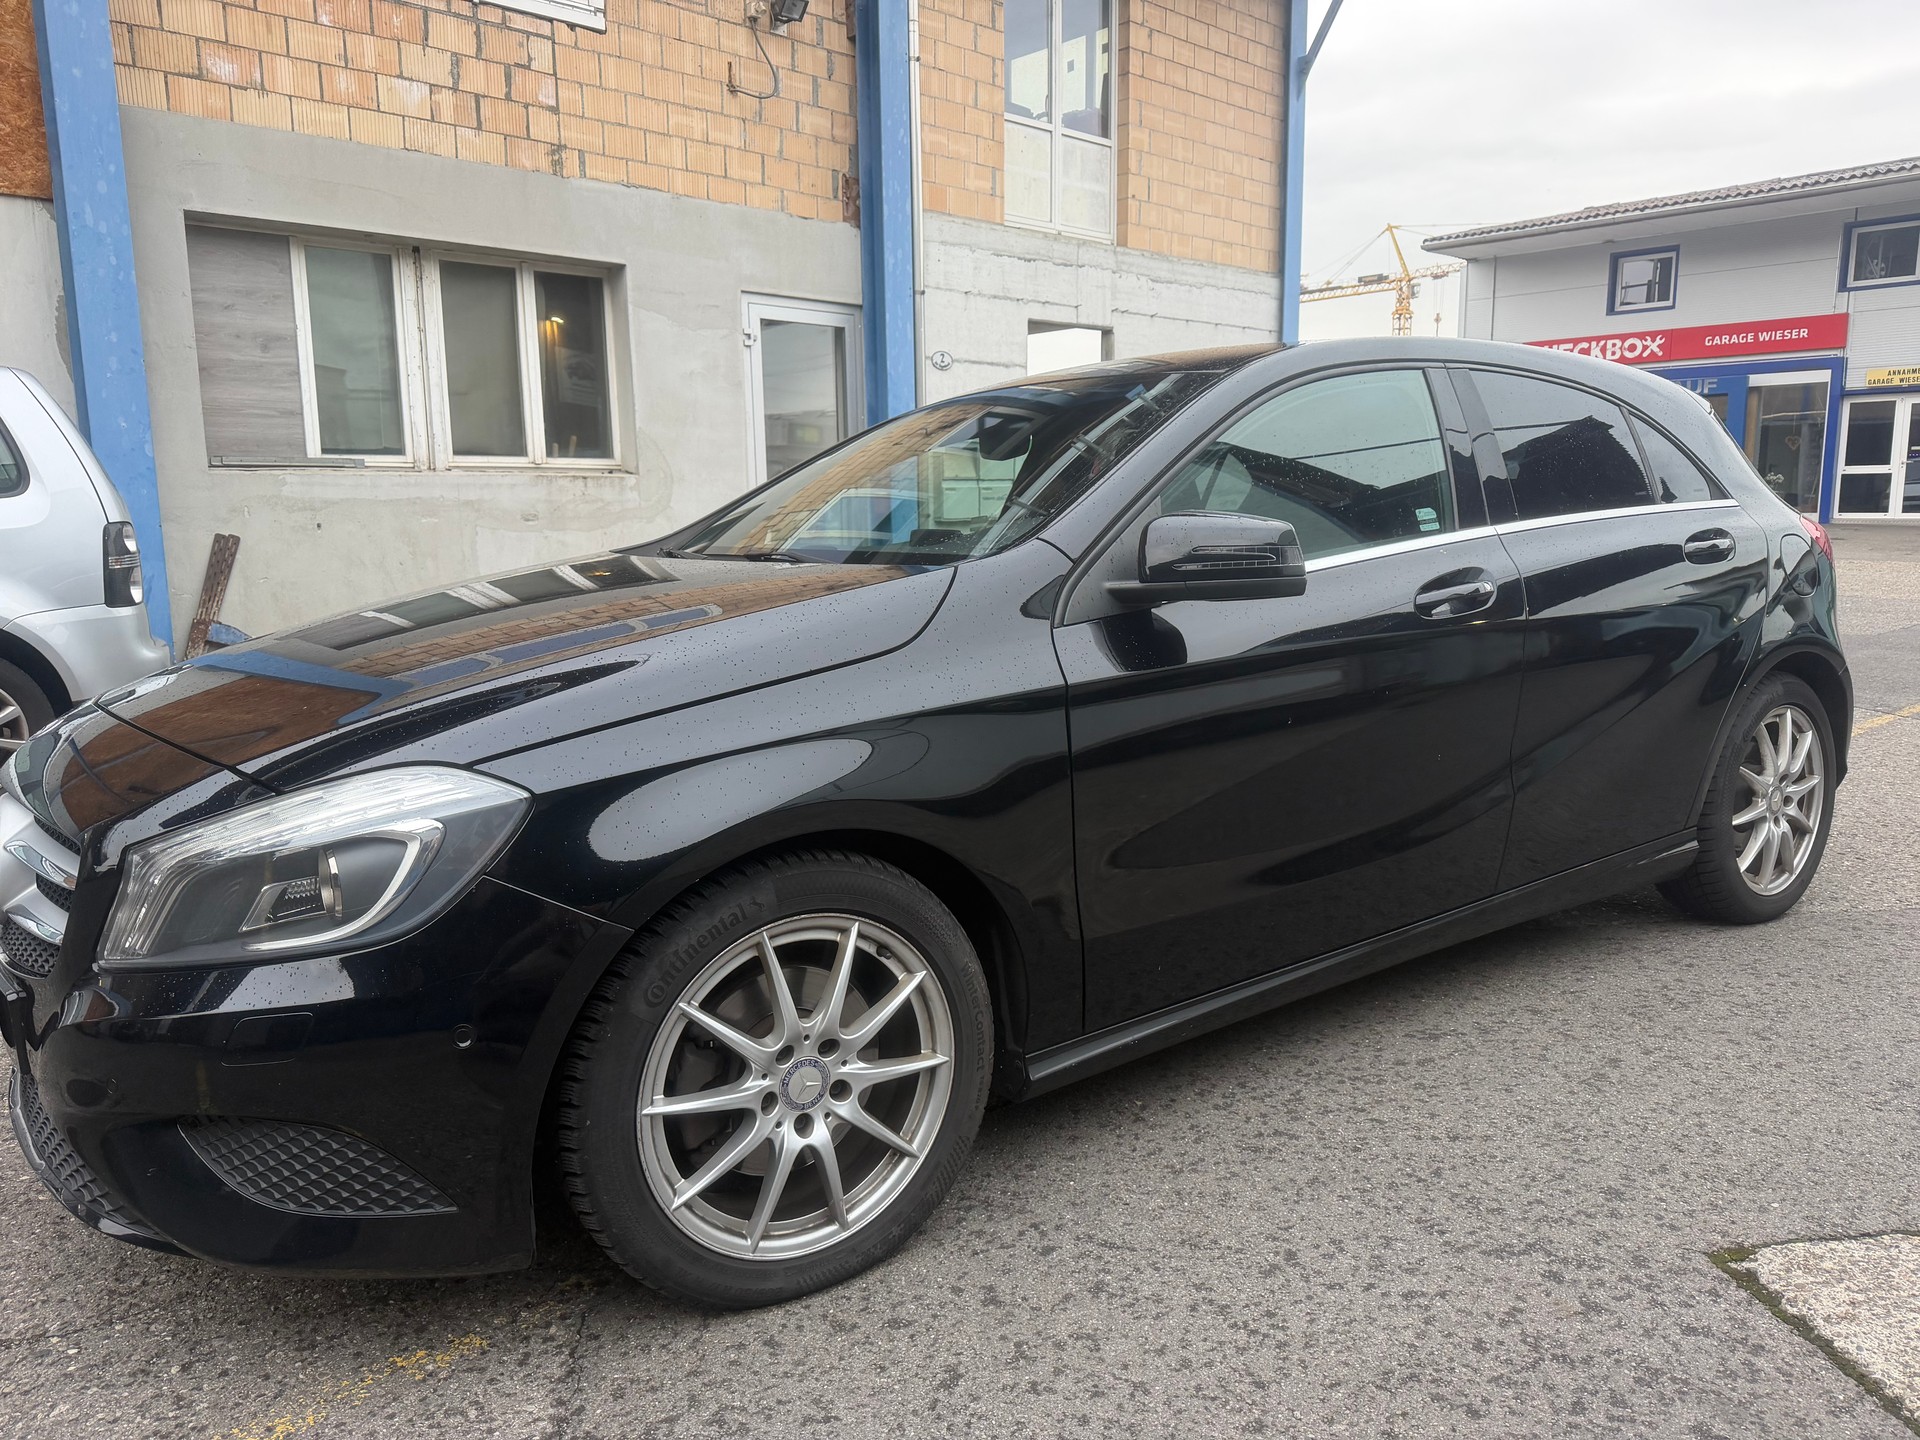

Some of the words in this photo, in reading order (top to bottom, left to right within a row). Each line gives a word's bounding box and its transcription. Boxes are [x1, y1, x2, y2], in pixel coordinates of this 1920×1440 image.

[1705, 333, 1755, 346] GARAGE
[1759, 328, 1809, 342] WIESER
[940, 353, 946, 363] 2
[1675, 378, 1718, 394] UF
[1868, 377, 1895, 386] GARAGE
[643, 903, 748, 1008] Continental
[960, 962, 985, 1073] WinterContact
[783, 1060, 816, 1084] MERCEDES
